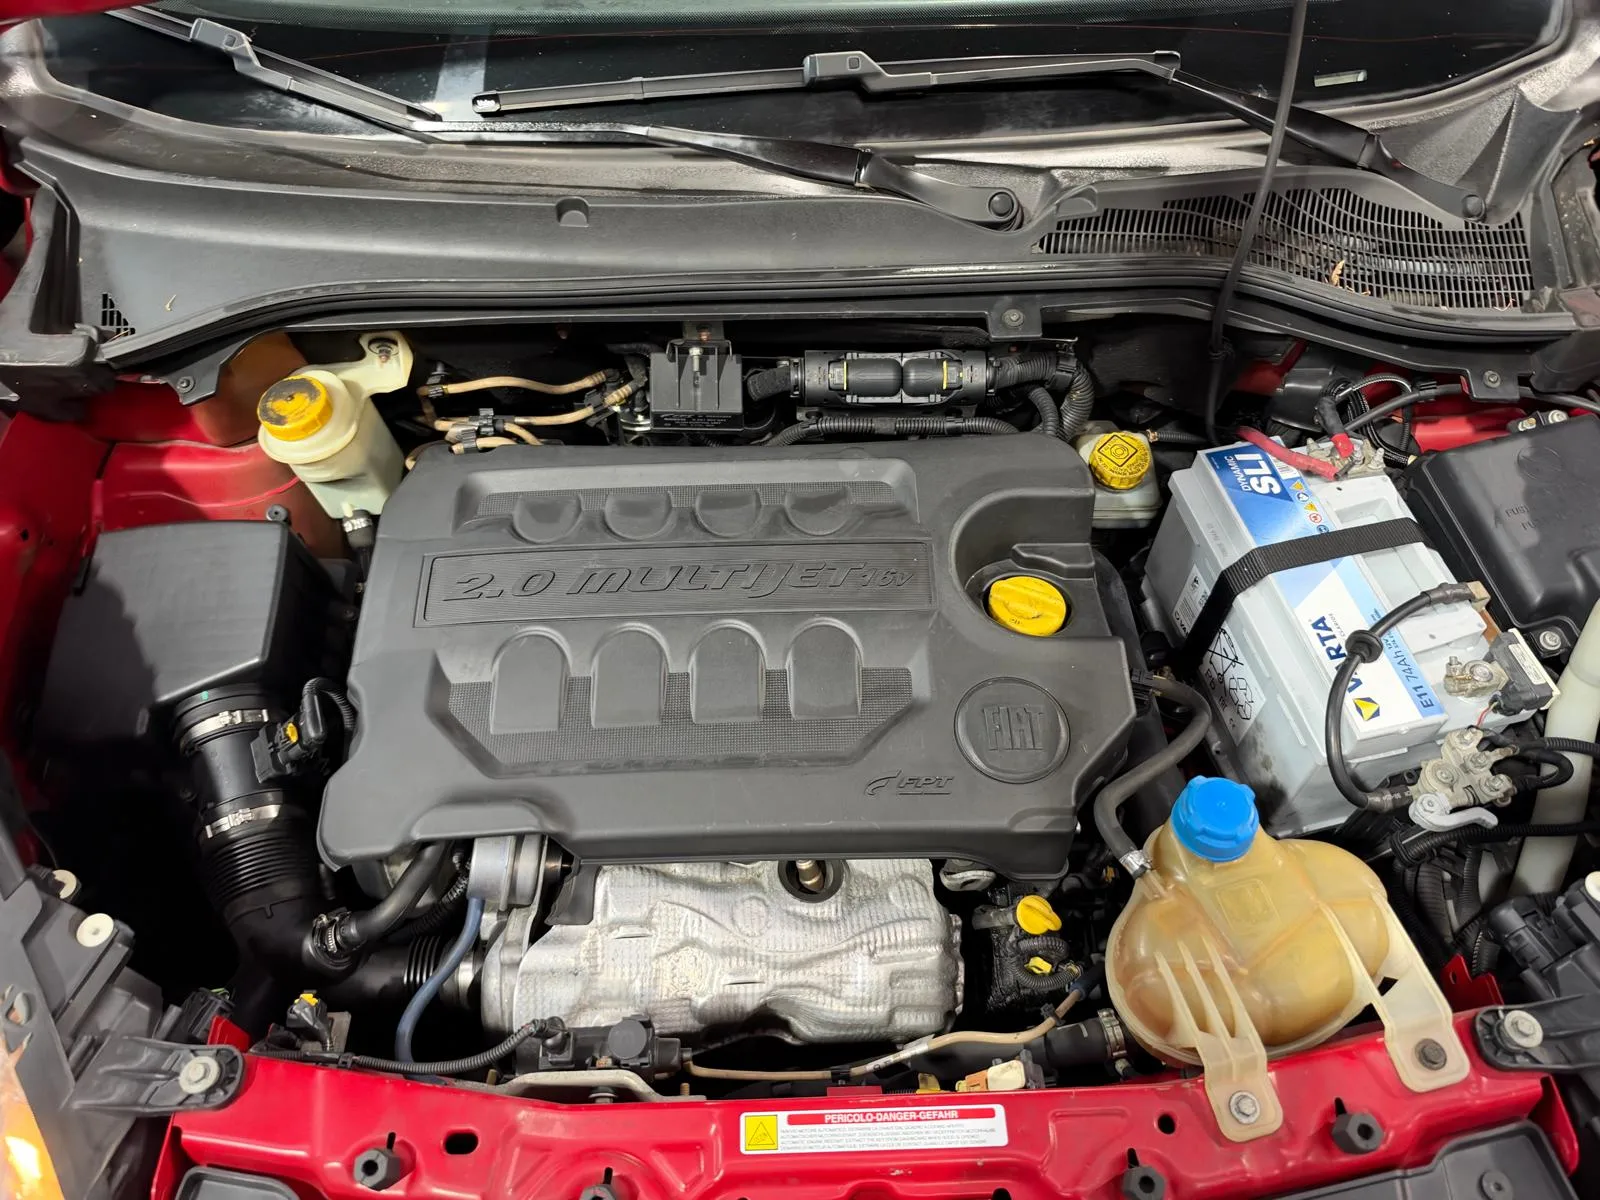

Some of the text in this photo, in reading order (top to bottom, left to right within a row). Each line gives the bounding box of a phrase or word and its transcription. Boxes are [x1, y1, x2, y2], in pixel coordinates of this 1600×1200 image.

[1224, 455, 1252, 492] DYNAMIC
[1234, 453, 1281, 495] SLI
[443, 569, 556, 601] 2.0
[1310, 615, 1363, 694] VRTA
[1392, 649, 1435, 709] E11 74Ah
[981, 703, 1044, 751] FIAT
[896, 775, 954, 789] FPT
[824, 1110, 959, 1124] PERICOLO-DANGER-GEFAHR
